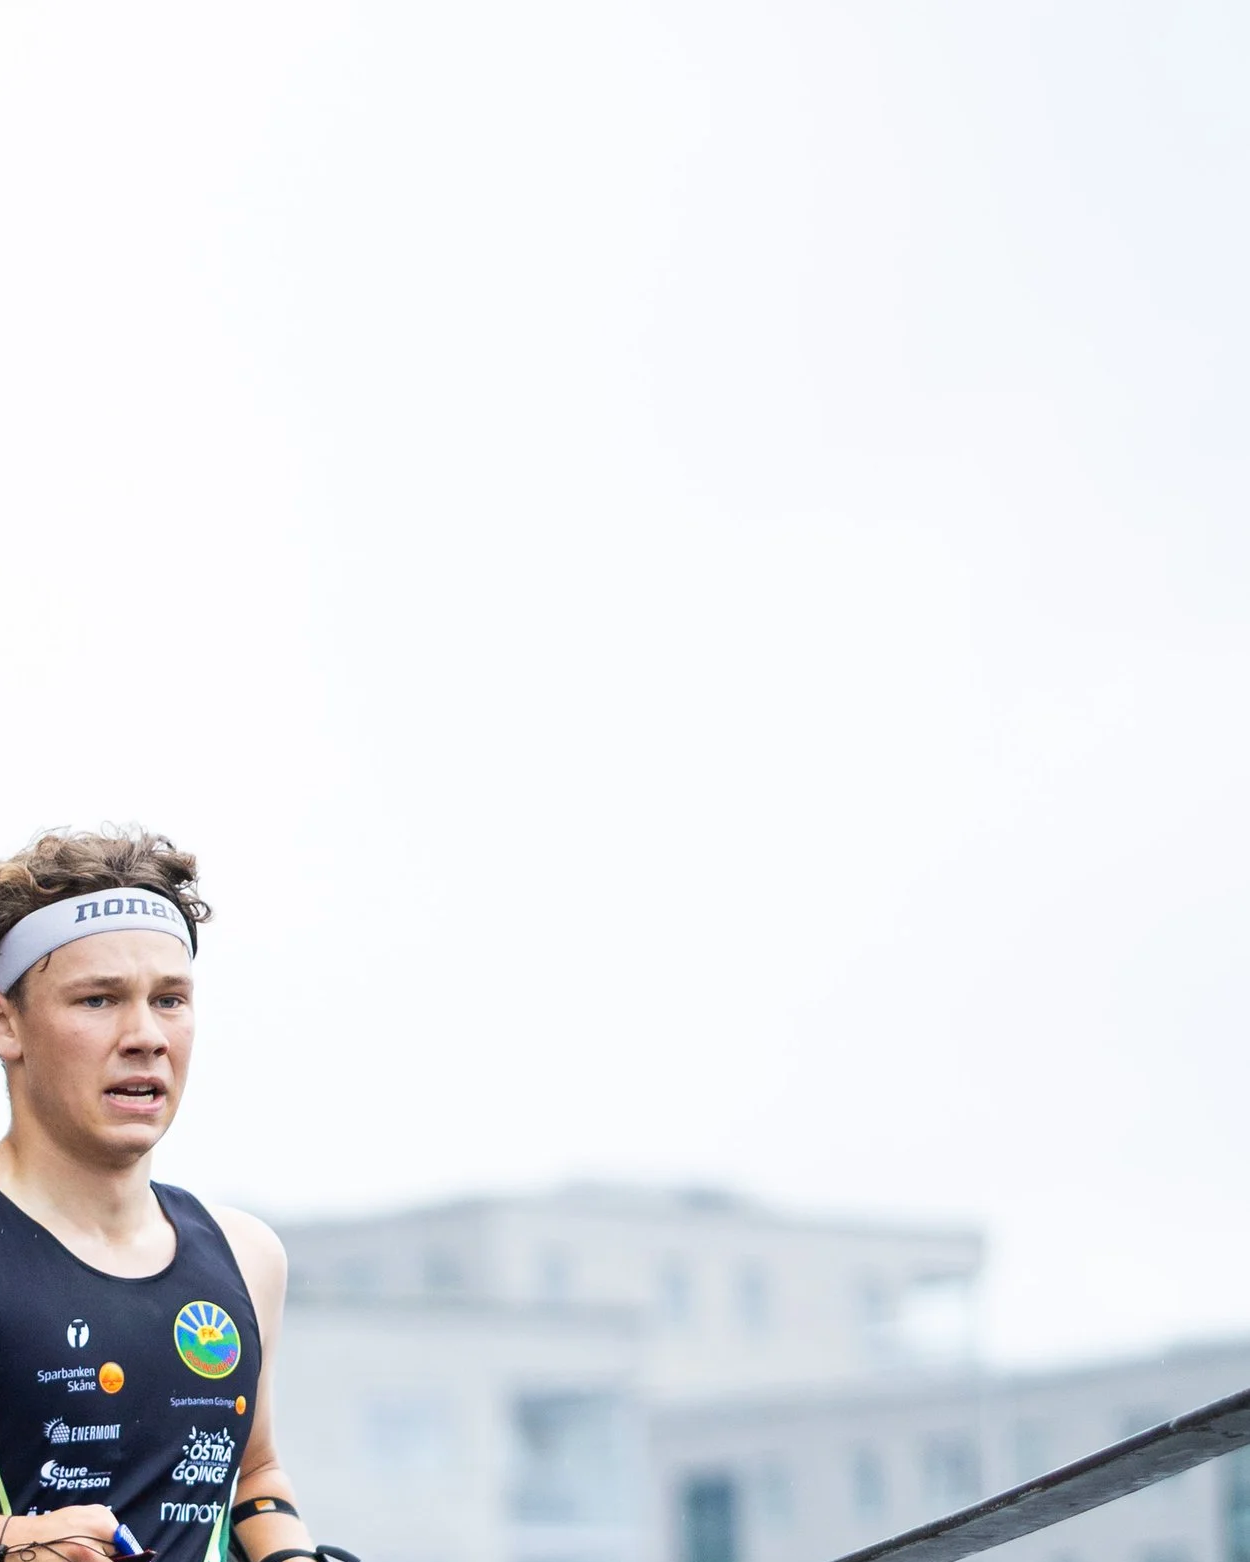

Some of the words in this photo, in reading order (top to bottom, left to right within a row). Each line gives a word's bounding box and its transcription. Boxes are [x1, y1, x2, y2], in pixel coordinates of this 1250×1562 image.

[202, 1327, 216, 1338] FK
[37, 1366, 95, 1383] Sparbanken
[67, 1379, 96, 1392] Skåne
[170, 1396, 214, 1407] Sparbanken
[71, 1424, 121, 1442] ENERMONT
[190, 1439, 232, 1462] ÖSTRA
